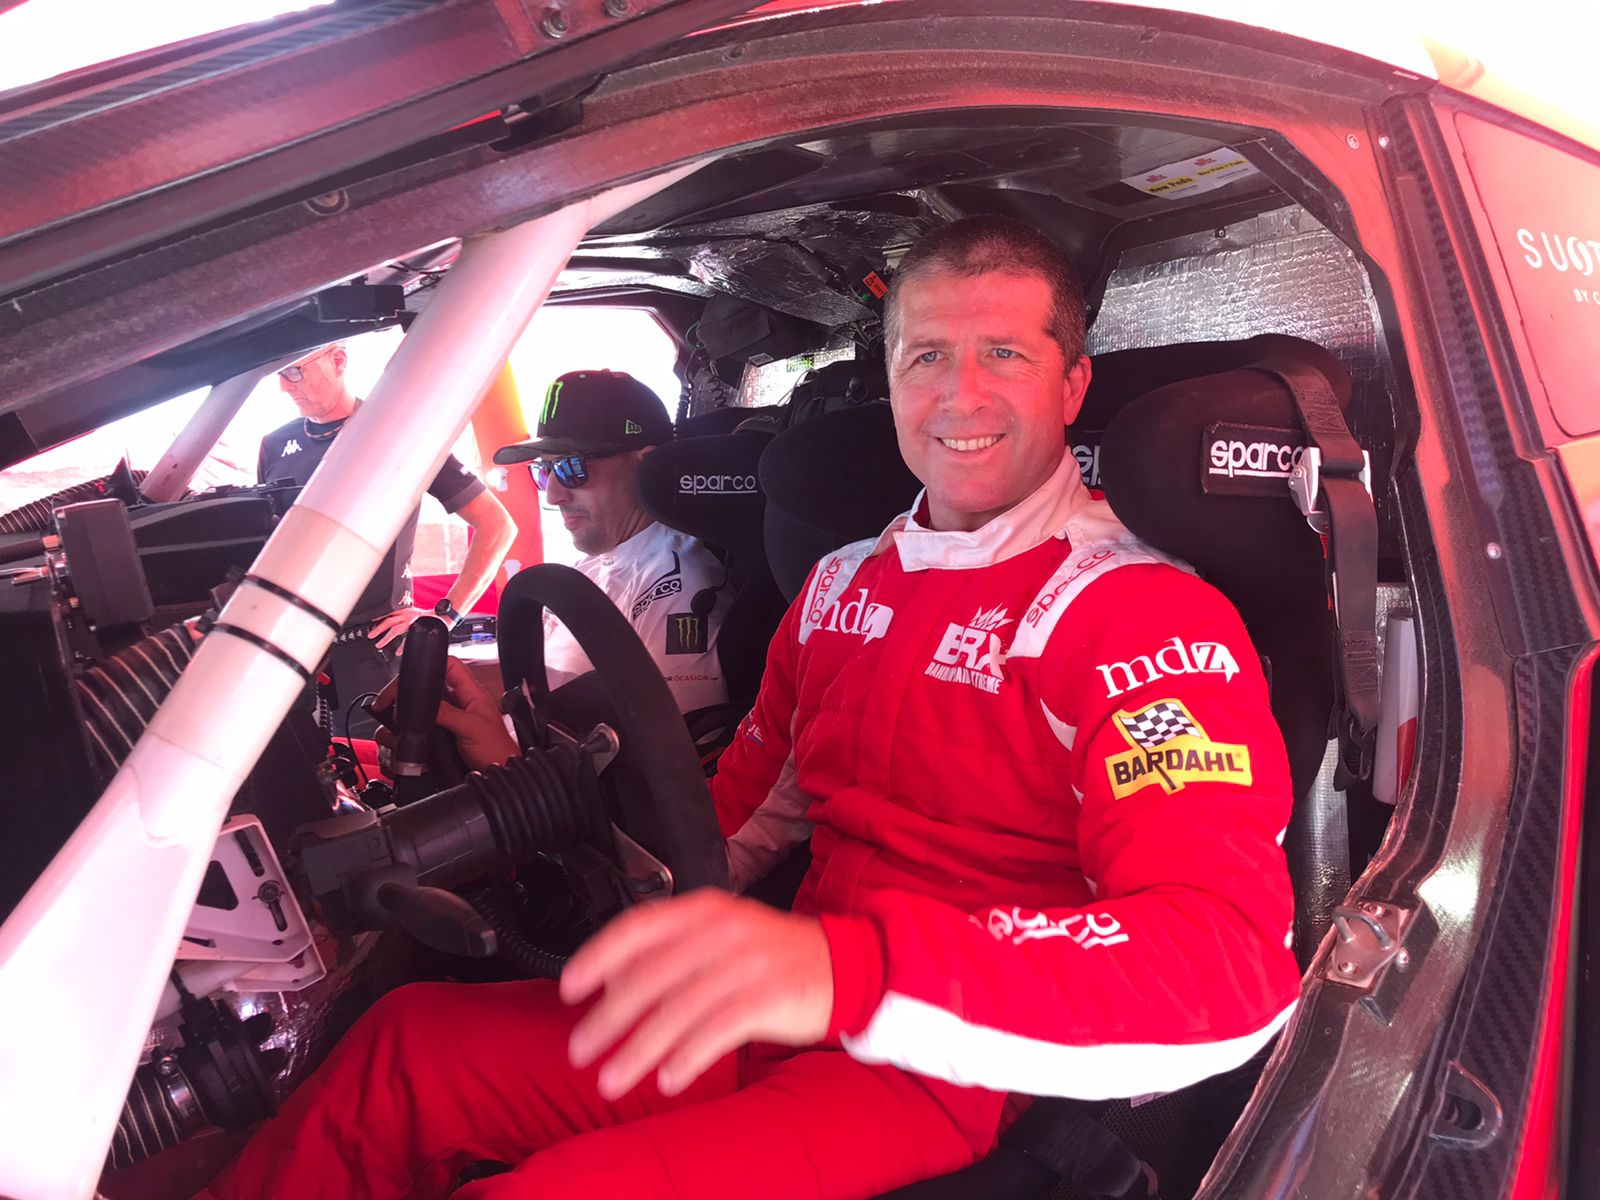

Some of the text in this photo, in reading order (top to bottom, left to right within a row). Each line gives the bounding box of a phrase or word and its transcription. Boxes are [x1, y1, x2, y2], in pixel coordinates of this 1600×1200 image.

[679, 474, 758, 496] sparco
[806, 556, 845, 624] sparco
[1096, 636, 1240, 699] mdz
[1112, 748, 1244, 785] BARDAHL
